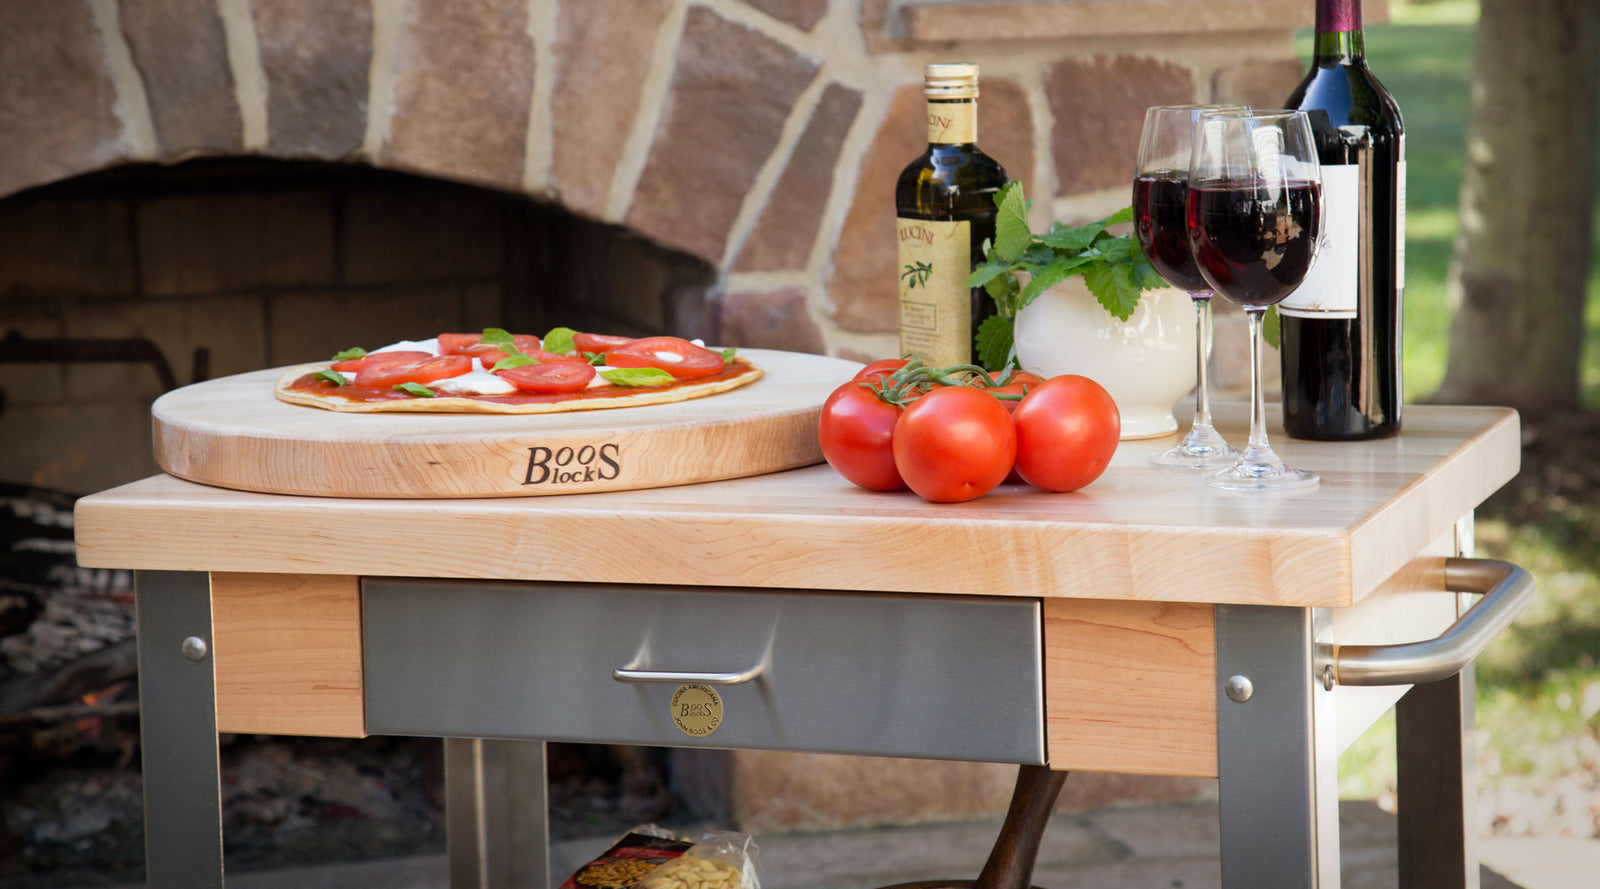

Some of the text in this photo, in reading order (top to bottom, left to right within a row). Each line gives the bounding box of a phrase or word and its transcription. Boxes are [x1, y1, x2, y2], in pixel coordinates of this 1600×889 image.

[900, 225, 935, 245] LUCINI
[672, 684, 719, 706] CUCINA AMERICANA
[674, 717, 688, 731] JOHN
